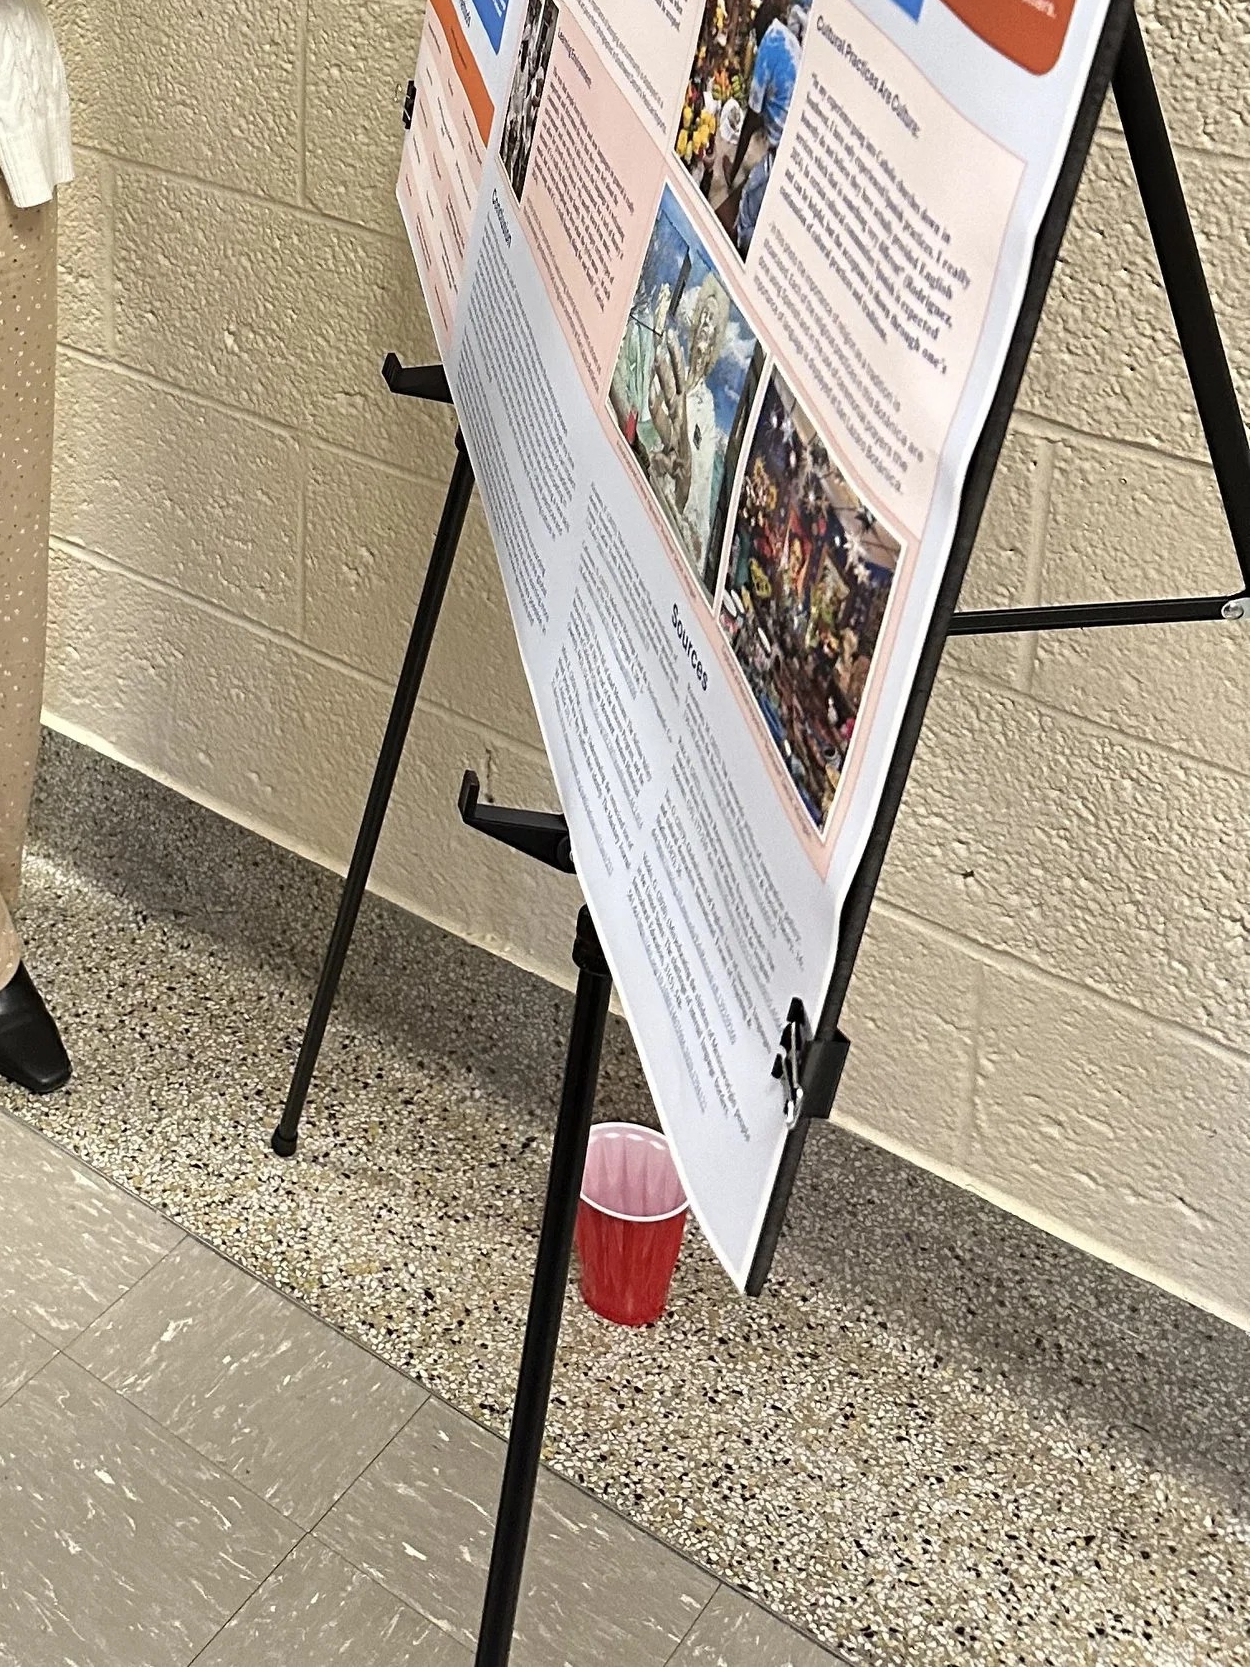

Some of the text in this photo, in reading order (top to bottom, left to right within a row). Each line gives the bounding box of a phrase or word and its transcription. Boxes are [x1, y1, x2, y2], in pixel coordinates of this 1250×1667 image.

[817, 15, 920, 139] Cultural Practices Are Culture:
[920, 209, 940, 235] down
[942, 232, 950, 244] in
[891, 234, 918, 270] provided
[919, 262, 952, 300] English
[942, 260, 970, 290] really
[901, 301, 940, 340] expected
[903, 275, 952, 328] (Rodriguez,
[890, 314, 920, 352] through
[922, 348, 947, 374] one's
[672, 603, 708, 691] Sources
